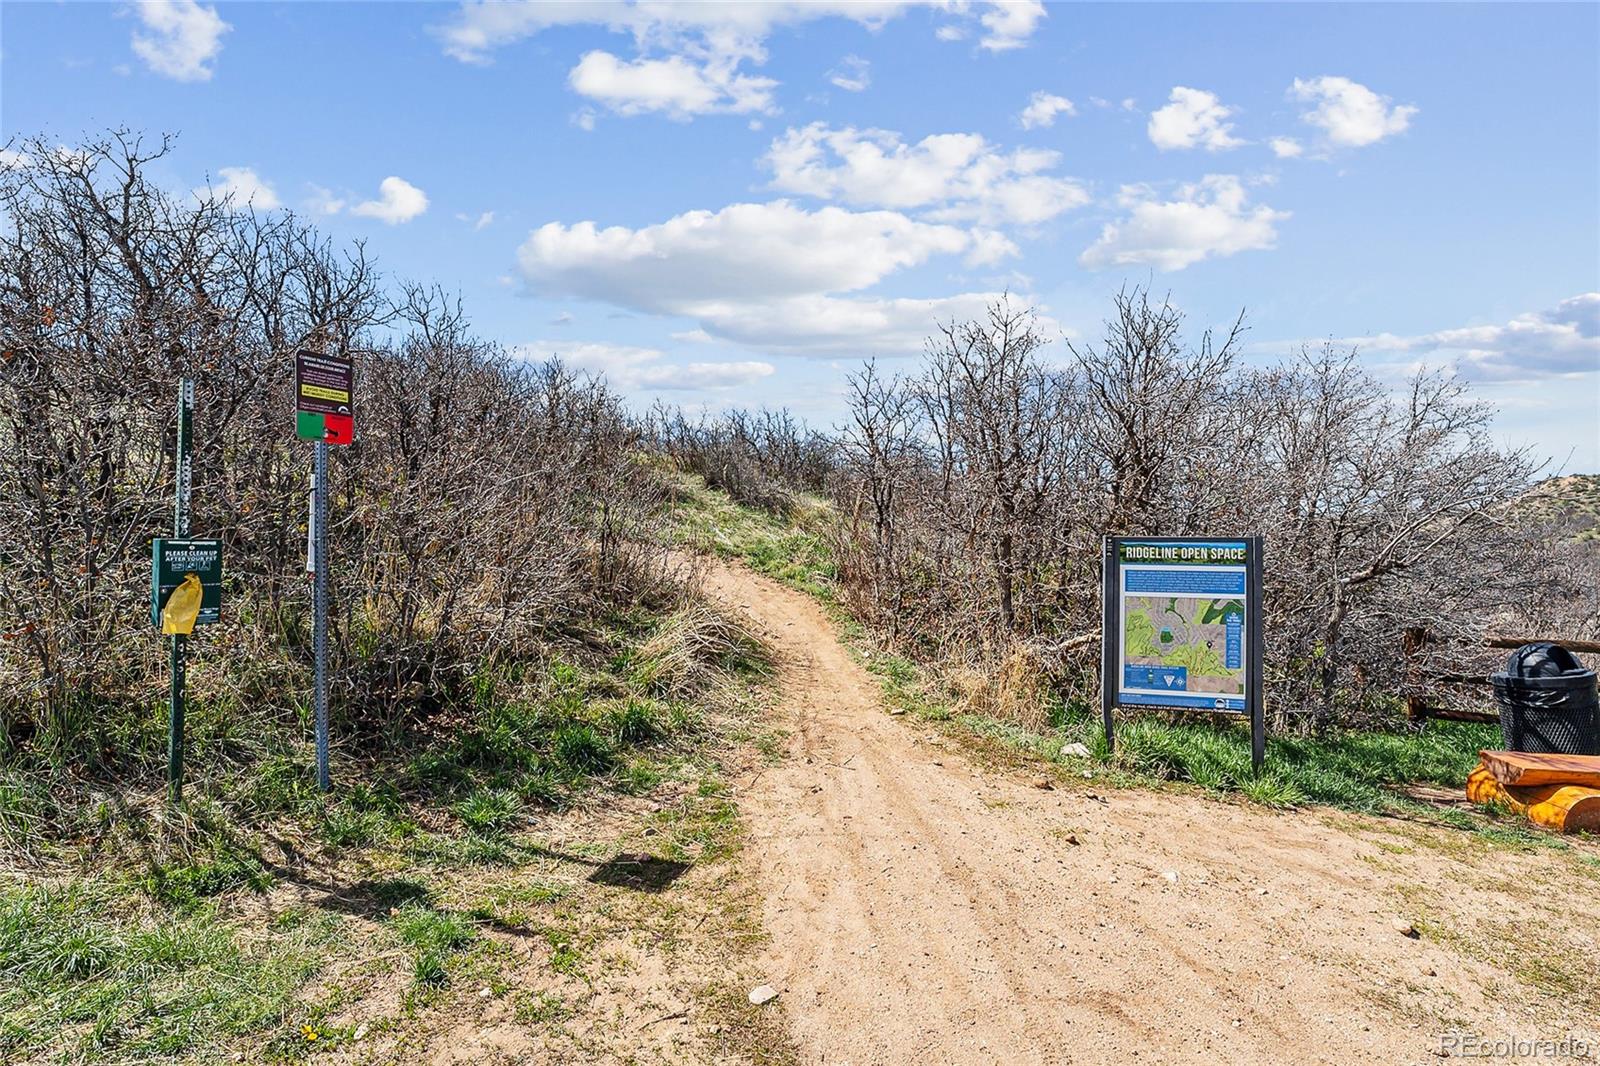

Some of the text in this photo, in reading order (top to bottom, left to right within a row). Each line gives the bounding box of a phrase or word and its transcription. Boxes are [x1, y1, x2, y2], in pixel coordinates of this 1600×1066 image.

[1126, 546, 1245, 560] RIDGELINE OPEN SPACE
